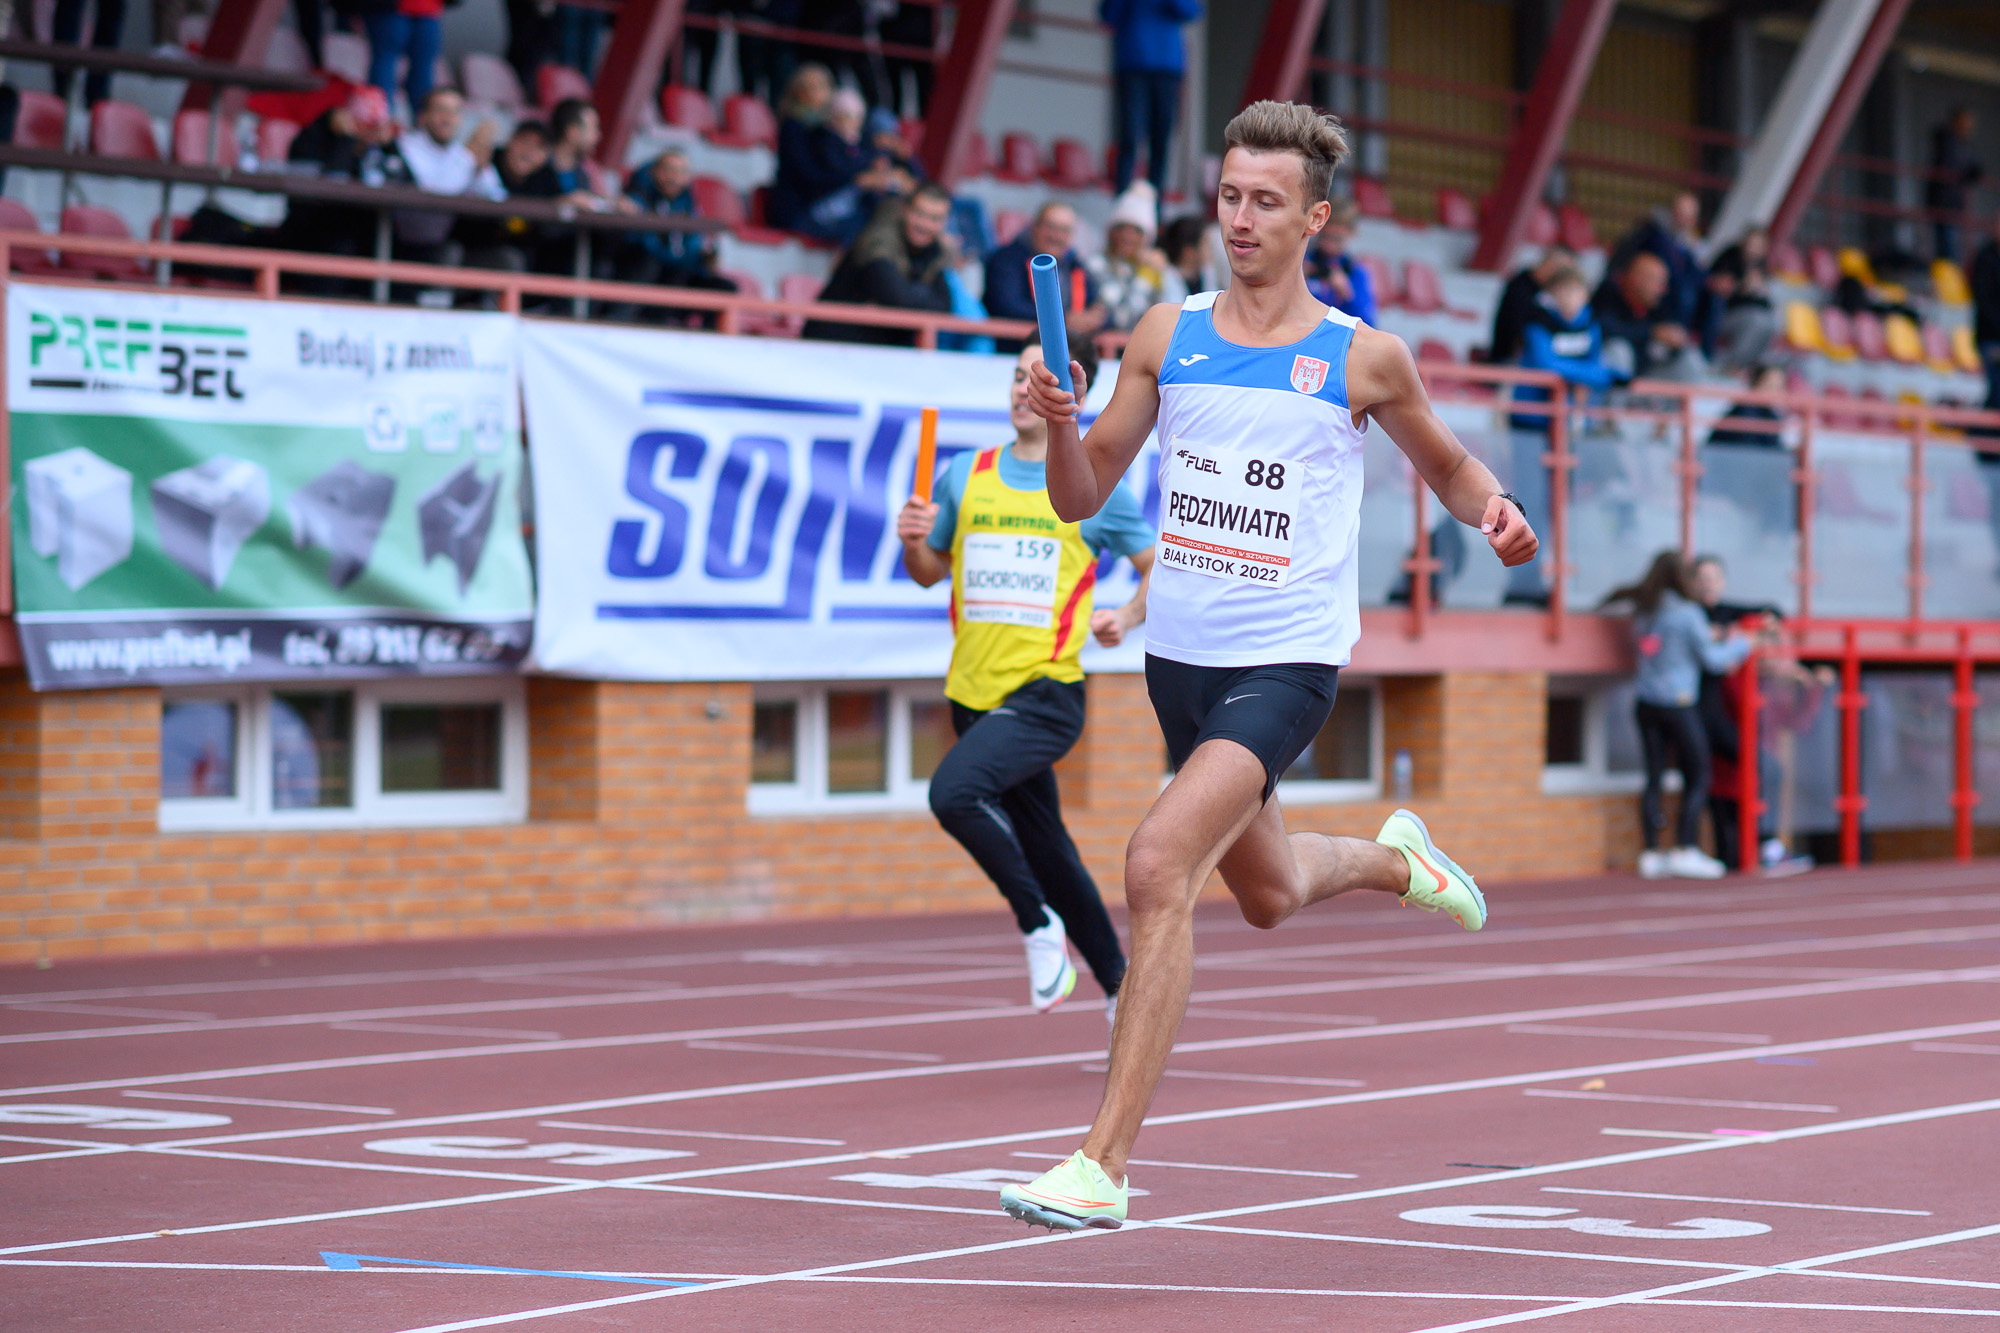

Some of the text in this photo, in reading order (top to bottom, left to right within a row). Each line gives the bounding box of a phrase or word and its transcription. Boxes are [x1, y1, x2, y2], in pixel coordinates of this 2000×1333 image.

[1185, 455, 1222, 475] FUEL
[1244, 459, 1285, 490] 88
[1169, 490, 1291, 541] PĘDZIWIATR
[1015, 540, 1054, 560] 159
[1163, 548, 1279, 582] BIAŁYSTOK 2022
[1214, 546, 1237, 556] POLSKI
[1245, 552, 1287, 564] SZTAFETACH
[966, 570, 1053, 594] SUCHOROWSKI
[363, 1135, 699, 1166] 5
[1399, 1205, 1773, 1240] 3
